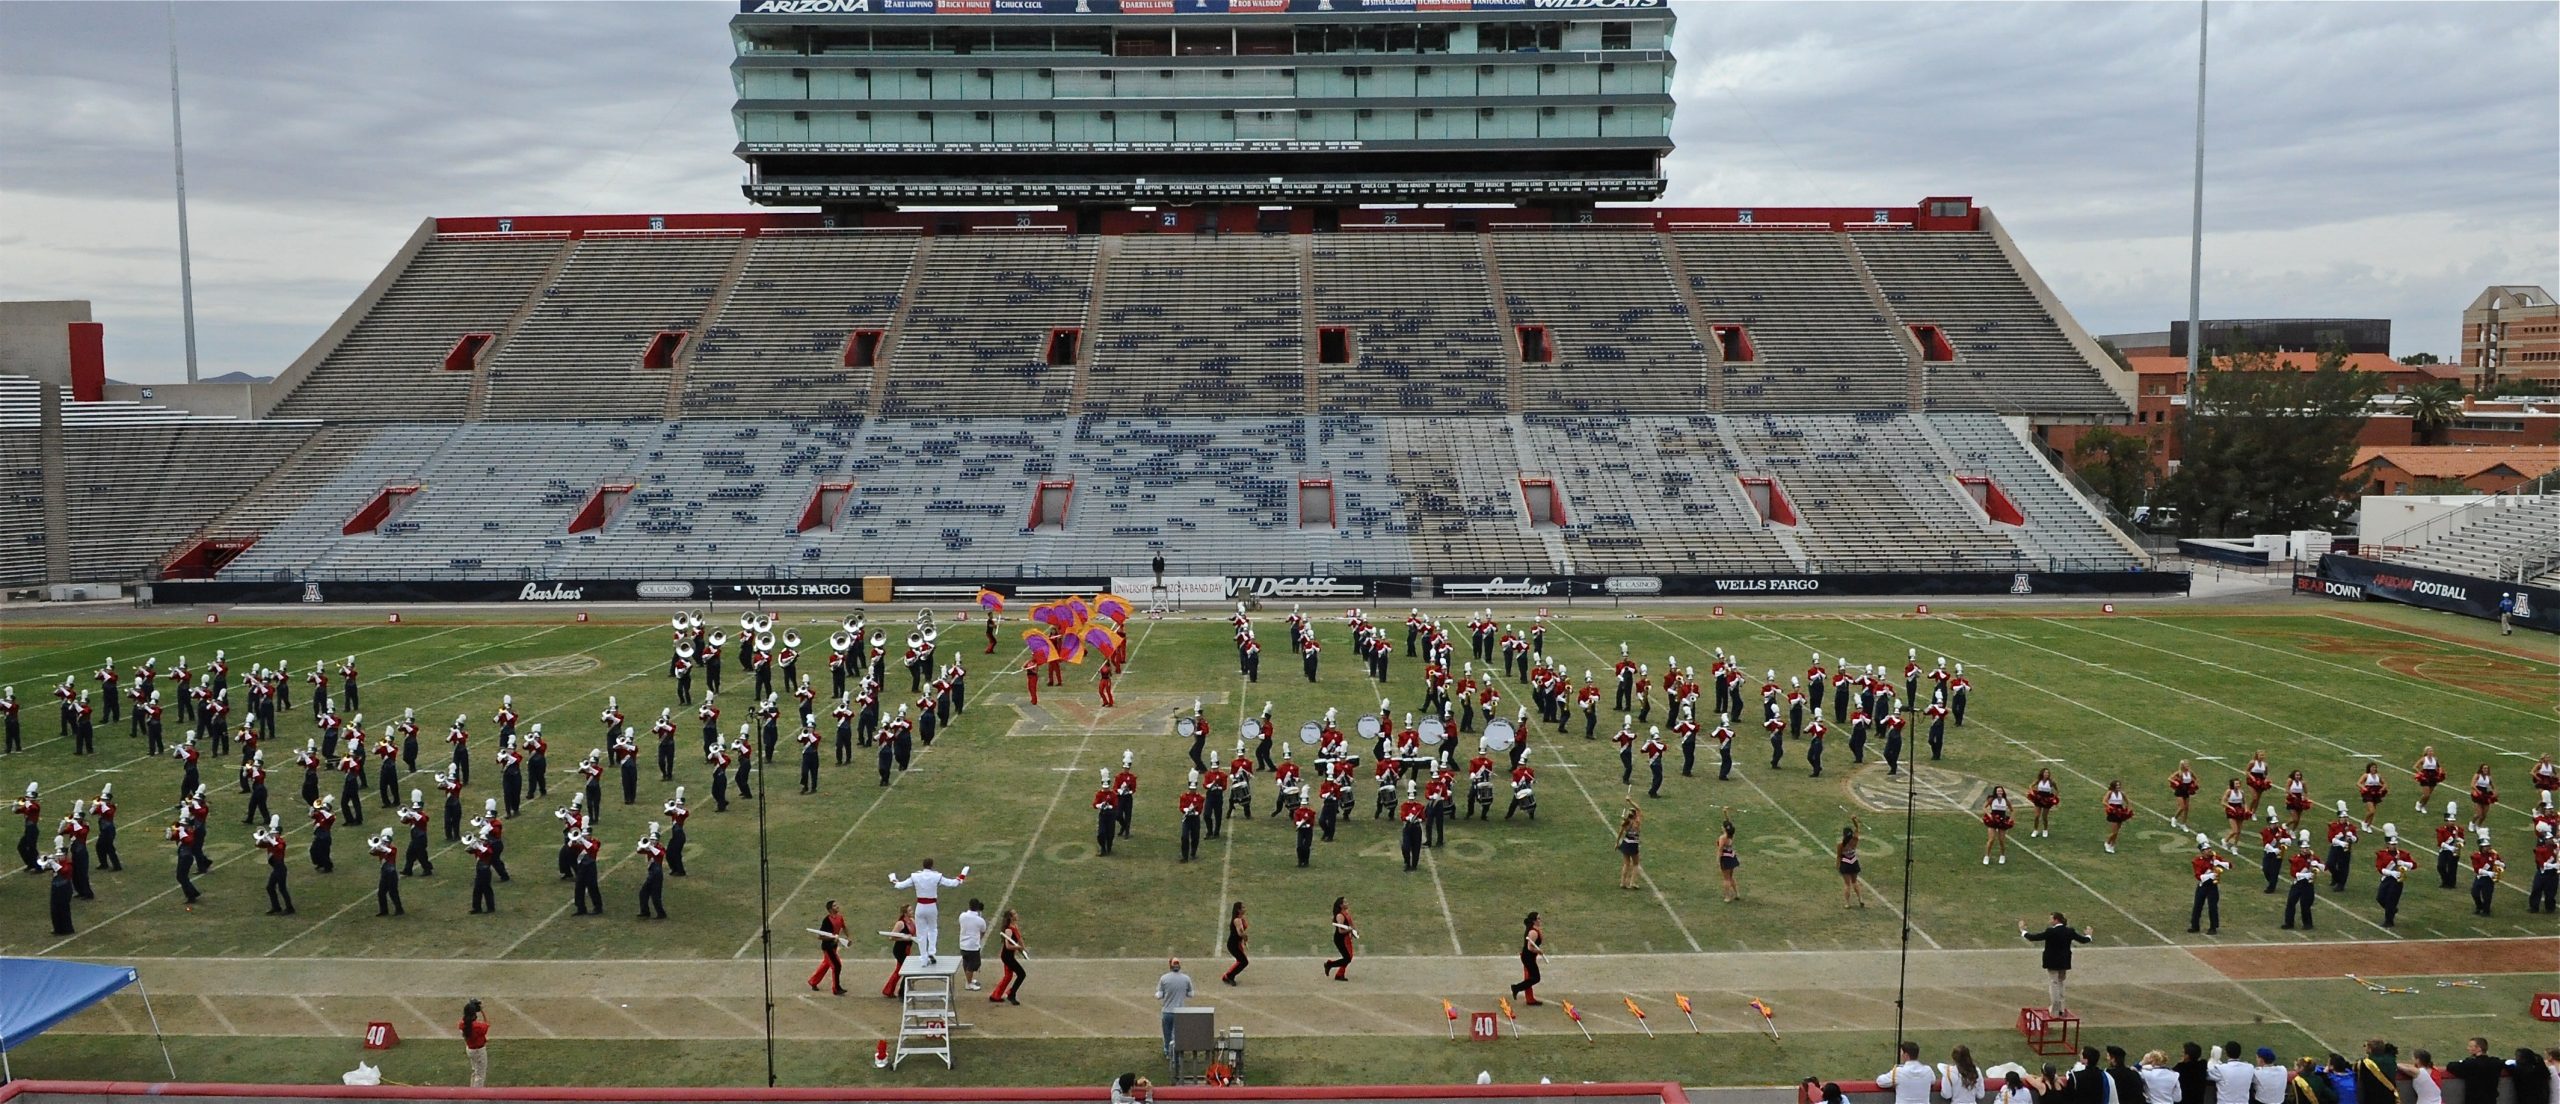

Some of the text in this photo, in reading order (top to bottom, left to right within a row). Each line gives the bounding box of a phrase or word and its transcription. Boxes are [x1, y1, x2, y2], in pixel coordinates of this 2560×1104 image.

[753, 0, 869, 12] ARIZONA
[1001, 0, 1024, 8] CHUCK
[1024, 0, 1042, 8] CECIL
[824, 219, 834, 228] 19
[1017, 218, 1030, 227] 20
[1164, 217, 1176, 225] 21
[1385, 216, 1397, 224] 22
[1580, 215, 1592, 223] 23
[1740, 215, 1752, 223] 24
[1875, 215, 1888, 223] 25
[500, 224, 510, 232] 17
[651, 221, 662, 230] 18
[142, 390, 152, 398] 16
[1115, 584, 1148, 593] UNIVERSITY
[1190, 584, 1207, 593] BAND
[1210, 584, 1222, 593] DAY
[1715, 580, 1819, 590] WELLS FARGO
[2011, 574, 2032, 594] A
[303, 583, 323, 602] A
[518, 582, 584, 600] Bashas'
[747, 585, 850, 595] WELLS FARGO
[2325, 582, 2360, 598] DOWN
[2412, 580, 2466, 600] FOOTBALL
[2513, 592, 2530, 618] A
[2540, 998, 2560, 1018] 20
[1475, 1017, 1494, 1036] 40
[367, 1026, 386, 1046] 40
